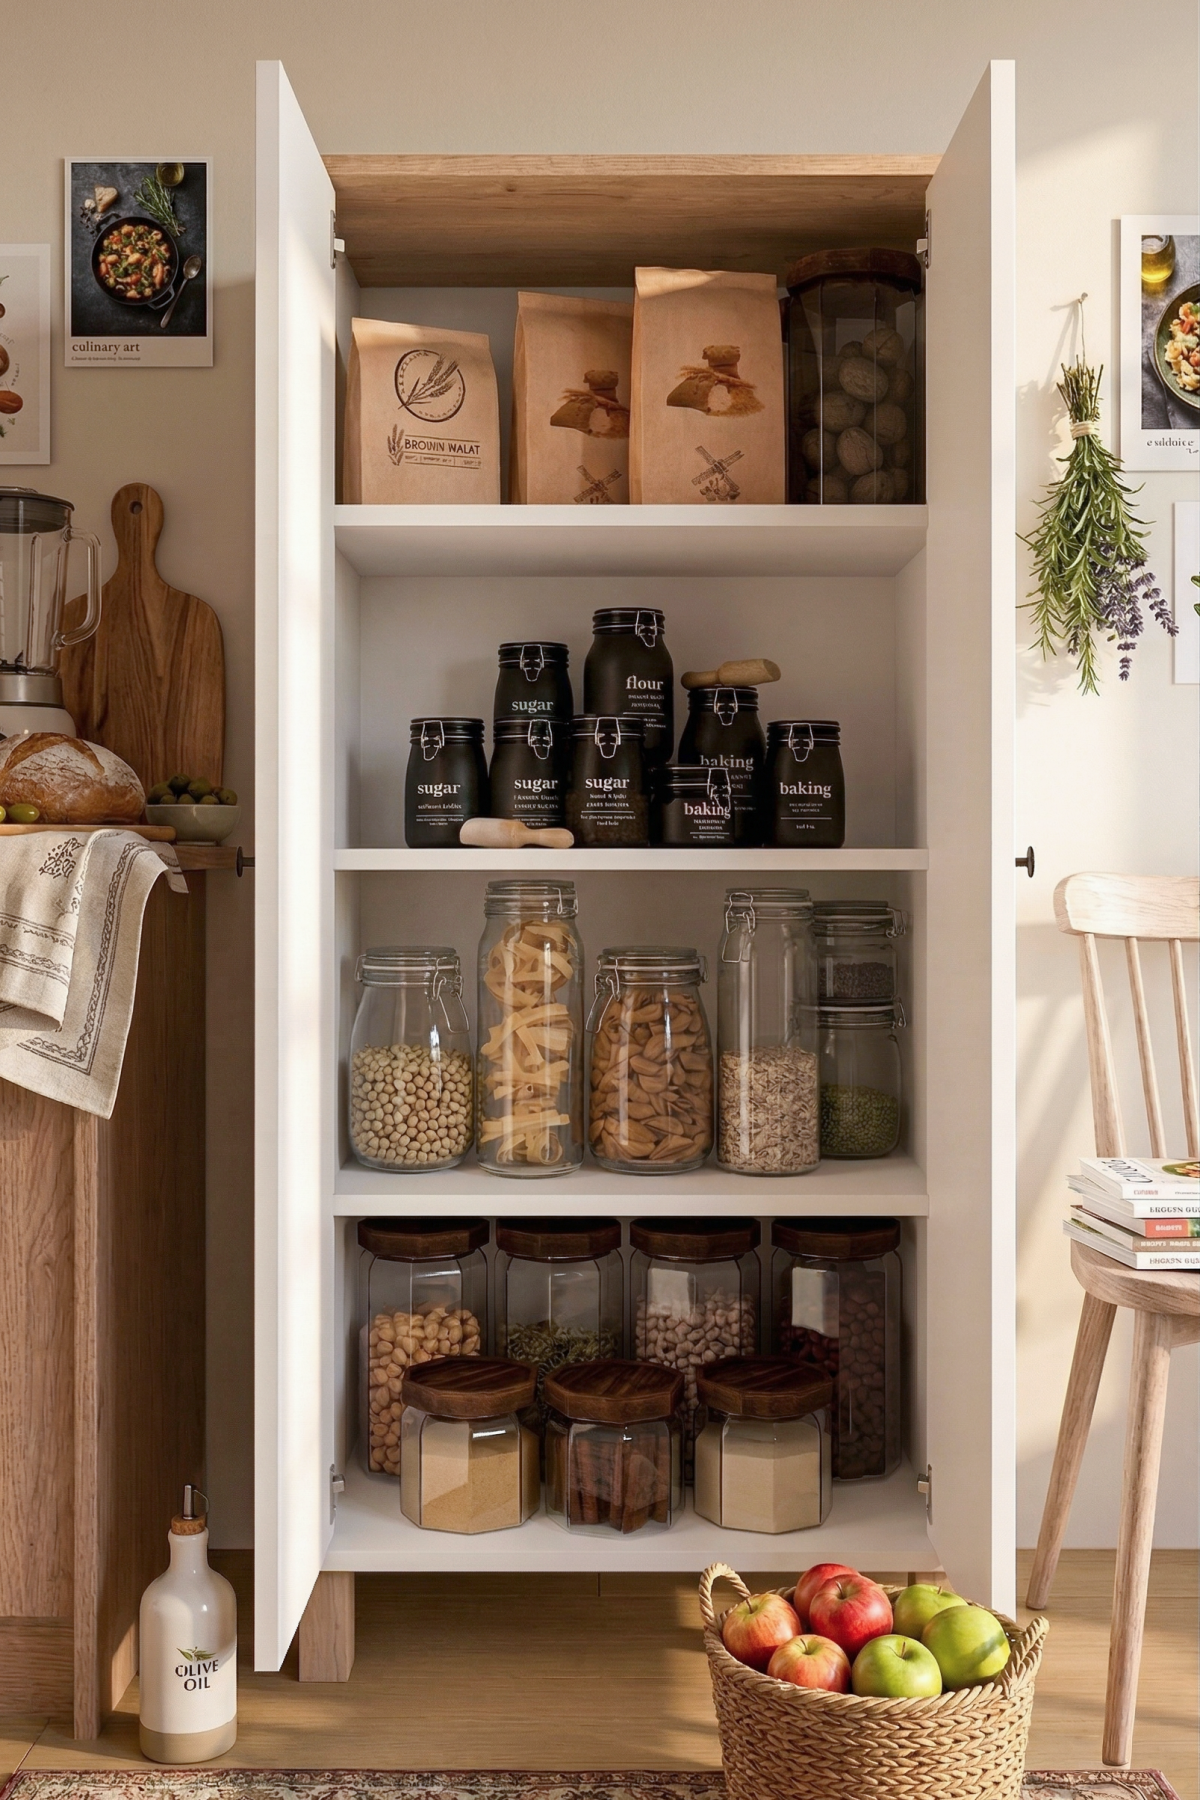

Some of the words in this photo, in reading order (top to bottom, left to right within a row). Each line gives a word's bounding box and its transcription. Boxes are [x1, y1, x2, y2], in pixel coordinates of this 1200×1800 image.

[72, 341, 120, 355] culinary
[123, 342, 140, 352] art
[448, 443, 480, 455] WALAT
[625, 674, 664, 690] flour
[511, 699, 554, 713] sugar
[699, 754, 754, 772] baking
[417, 783, 461, 797] sugar
[514, 778, 559, 793] sugar
[585, 776, 630, 792] sugar
[779, 781, 832, 799] baking
[683, 801, 731, 819] baking
[175, 1659, 219, 1677] OLIVE
[184, 1676, 211, 1691] OIL
